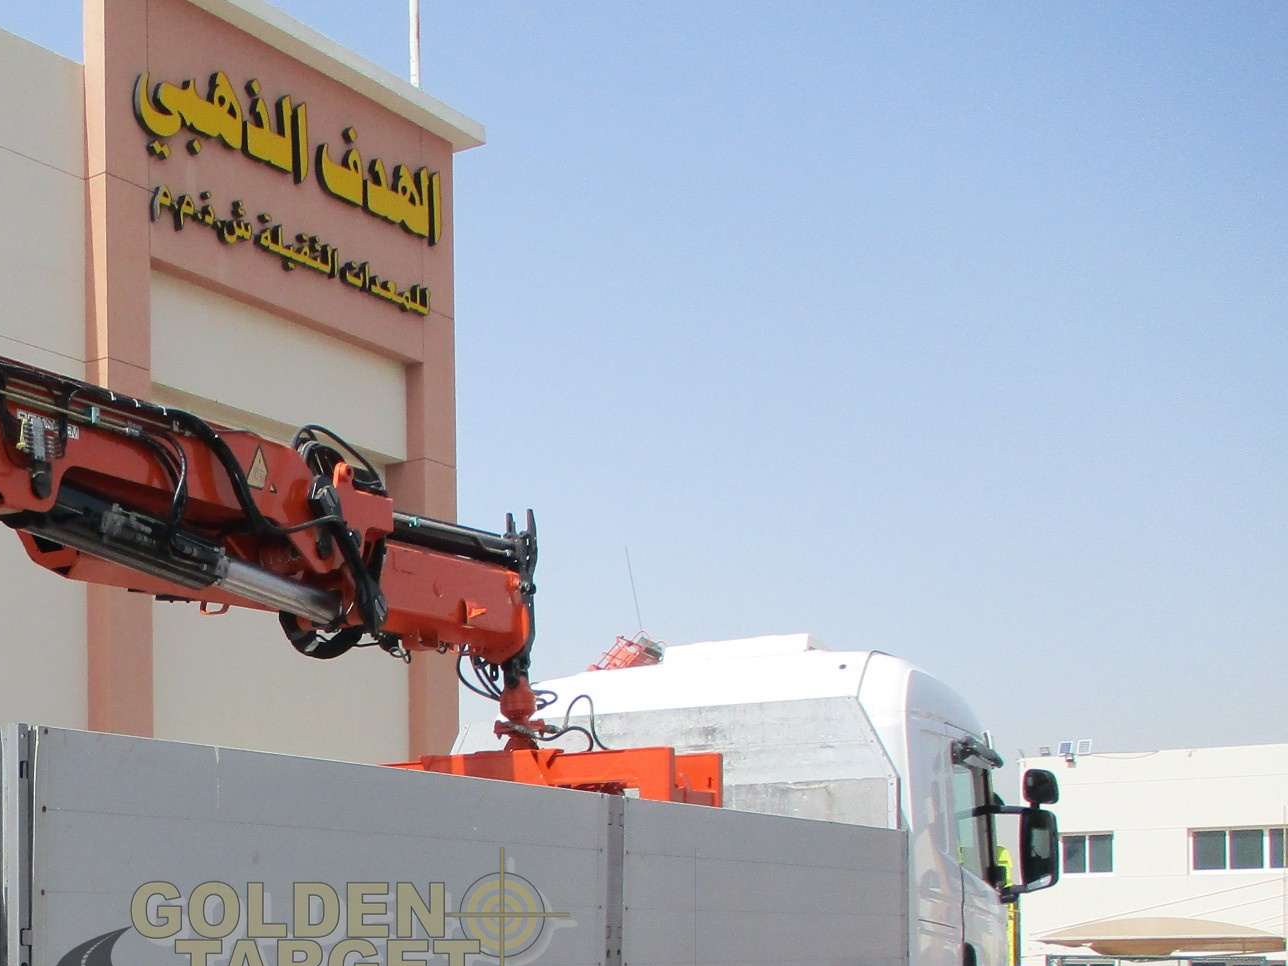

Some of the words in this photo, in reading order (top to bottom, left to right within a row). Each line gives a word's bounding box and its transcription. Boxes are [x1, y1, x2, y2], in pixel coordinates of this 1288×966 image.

[133, 71, 309, 184] الذهبي
[315, 126, 441, 246] الهدف
[253, 213, 340, 279] الثقيلة
[339, 260, 431, 317] للمعدات
